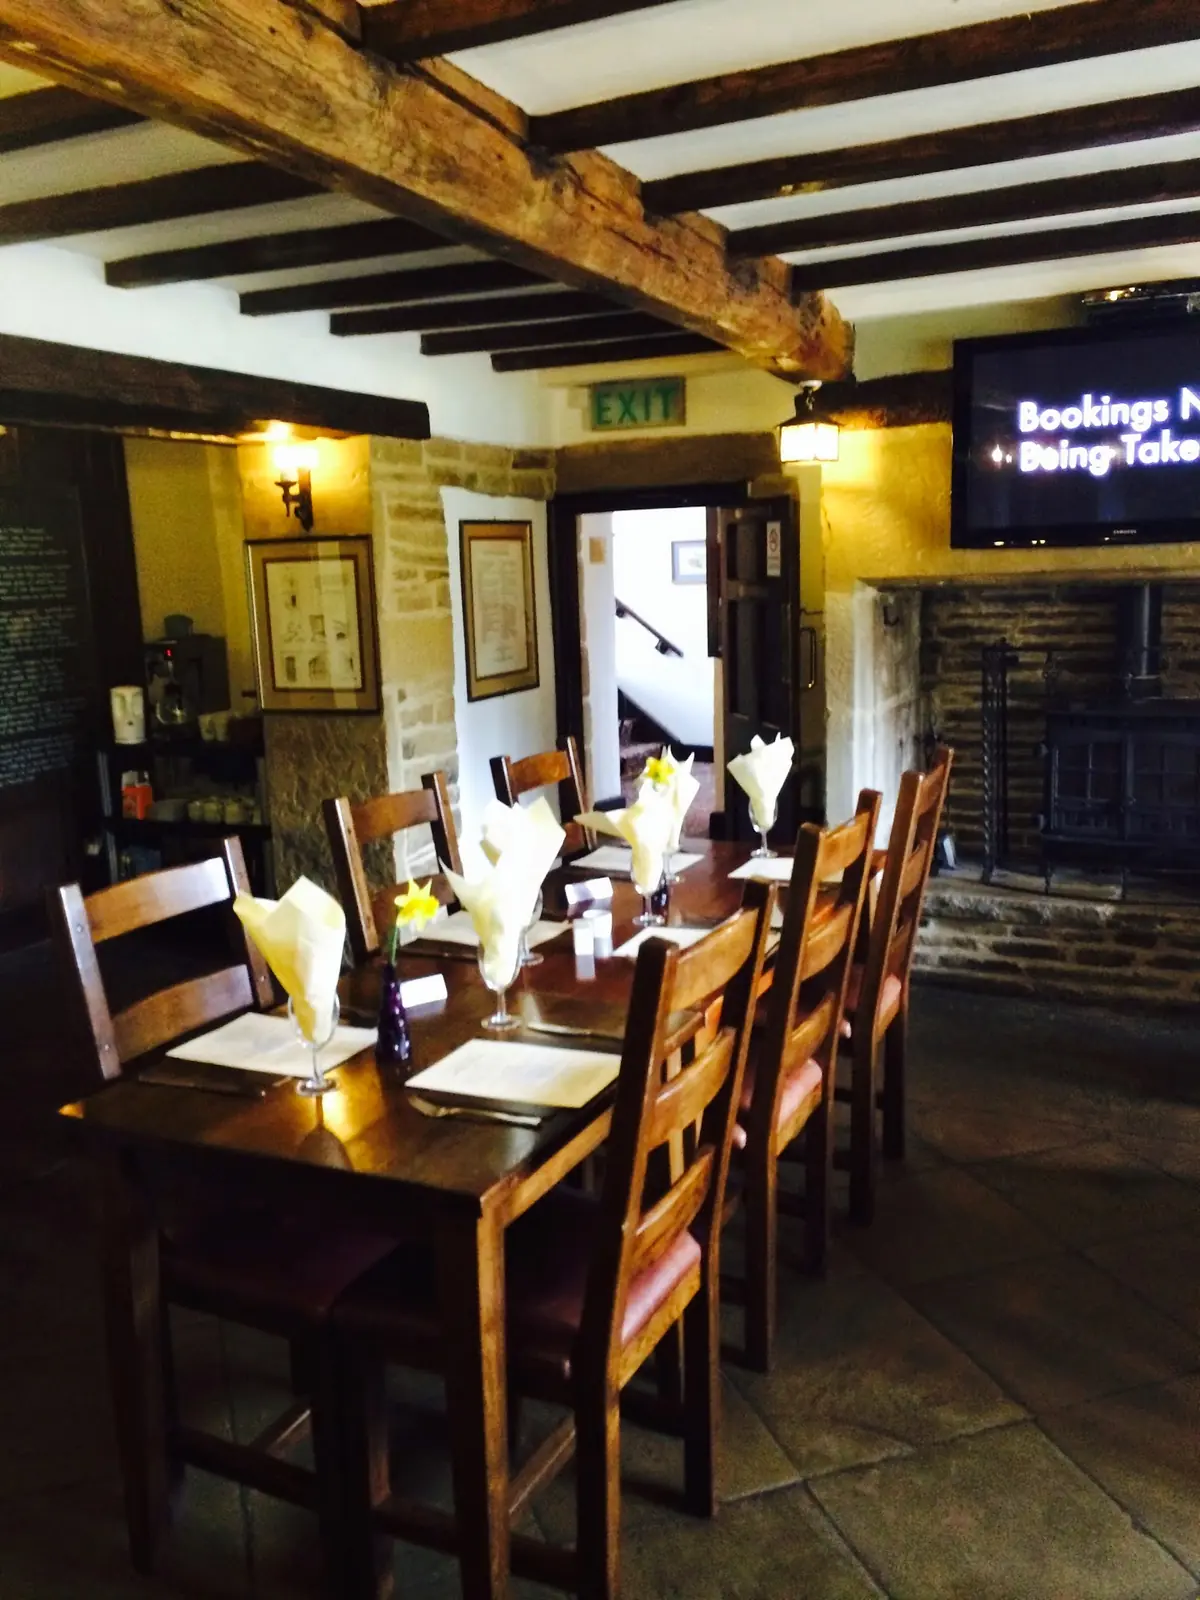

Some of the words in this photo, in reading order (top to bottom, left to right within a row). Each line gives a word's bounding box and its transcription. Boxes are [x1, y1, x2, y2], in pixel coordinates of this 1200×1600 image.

[596, 386, 676, 425] EXIT
[1019, 393, 1169, 433] Bookings
[1120, 429, 1200, 466] Take
